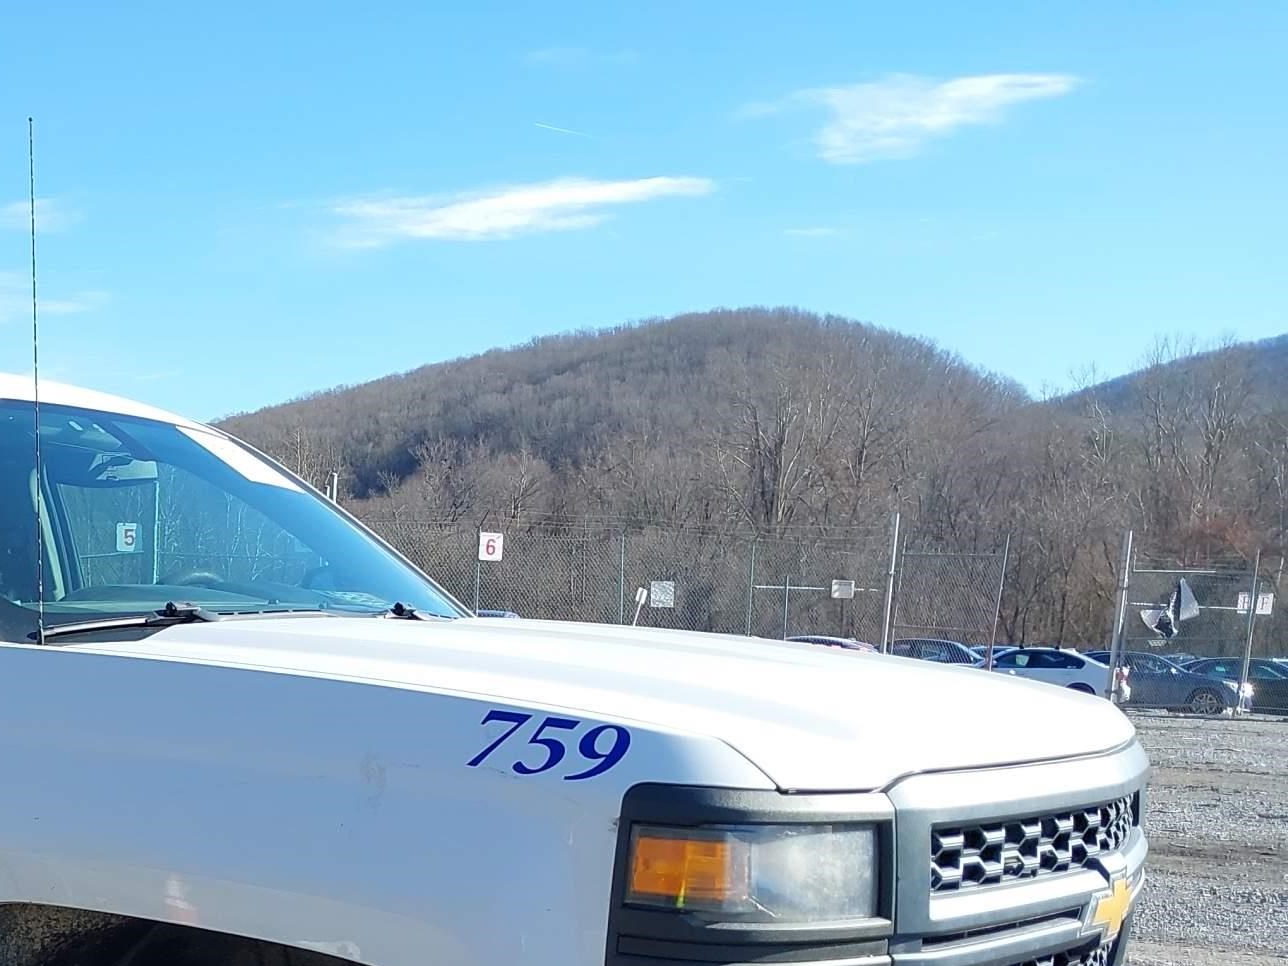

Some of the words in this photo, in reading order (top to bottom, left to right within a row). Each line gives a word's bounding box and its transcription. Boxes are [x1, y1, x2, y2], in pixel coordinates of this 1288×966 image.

[124, 528, 135, 546] 5
[486, 538, 496, 556] 6
[466, 709, 631, 781] 759
